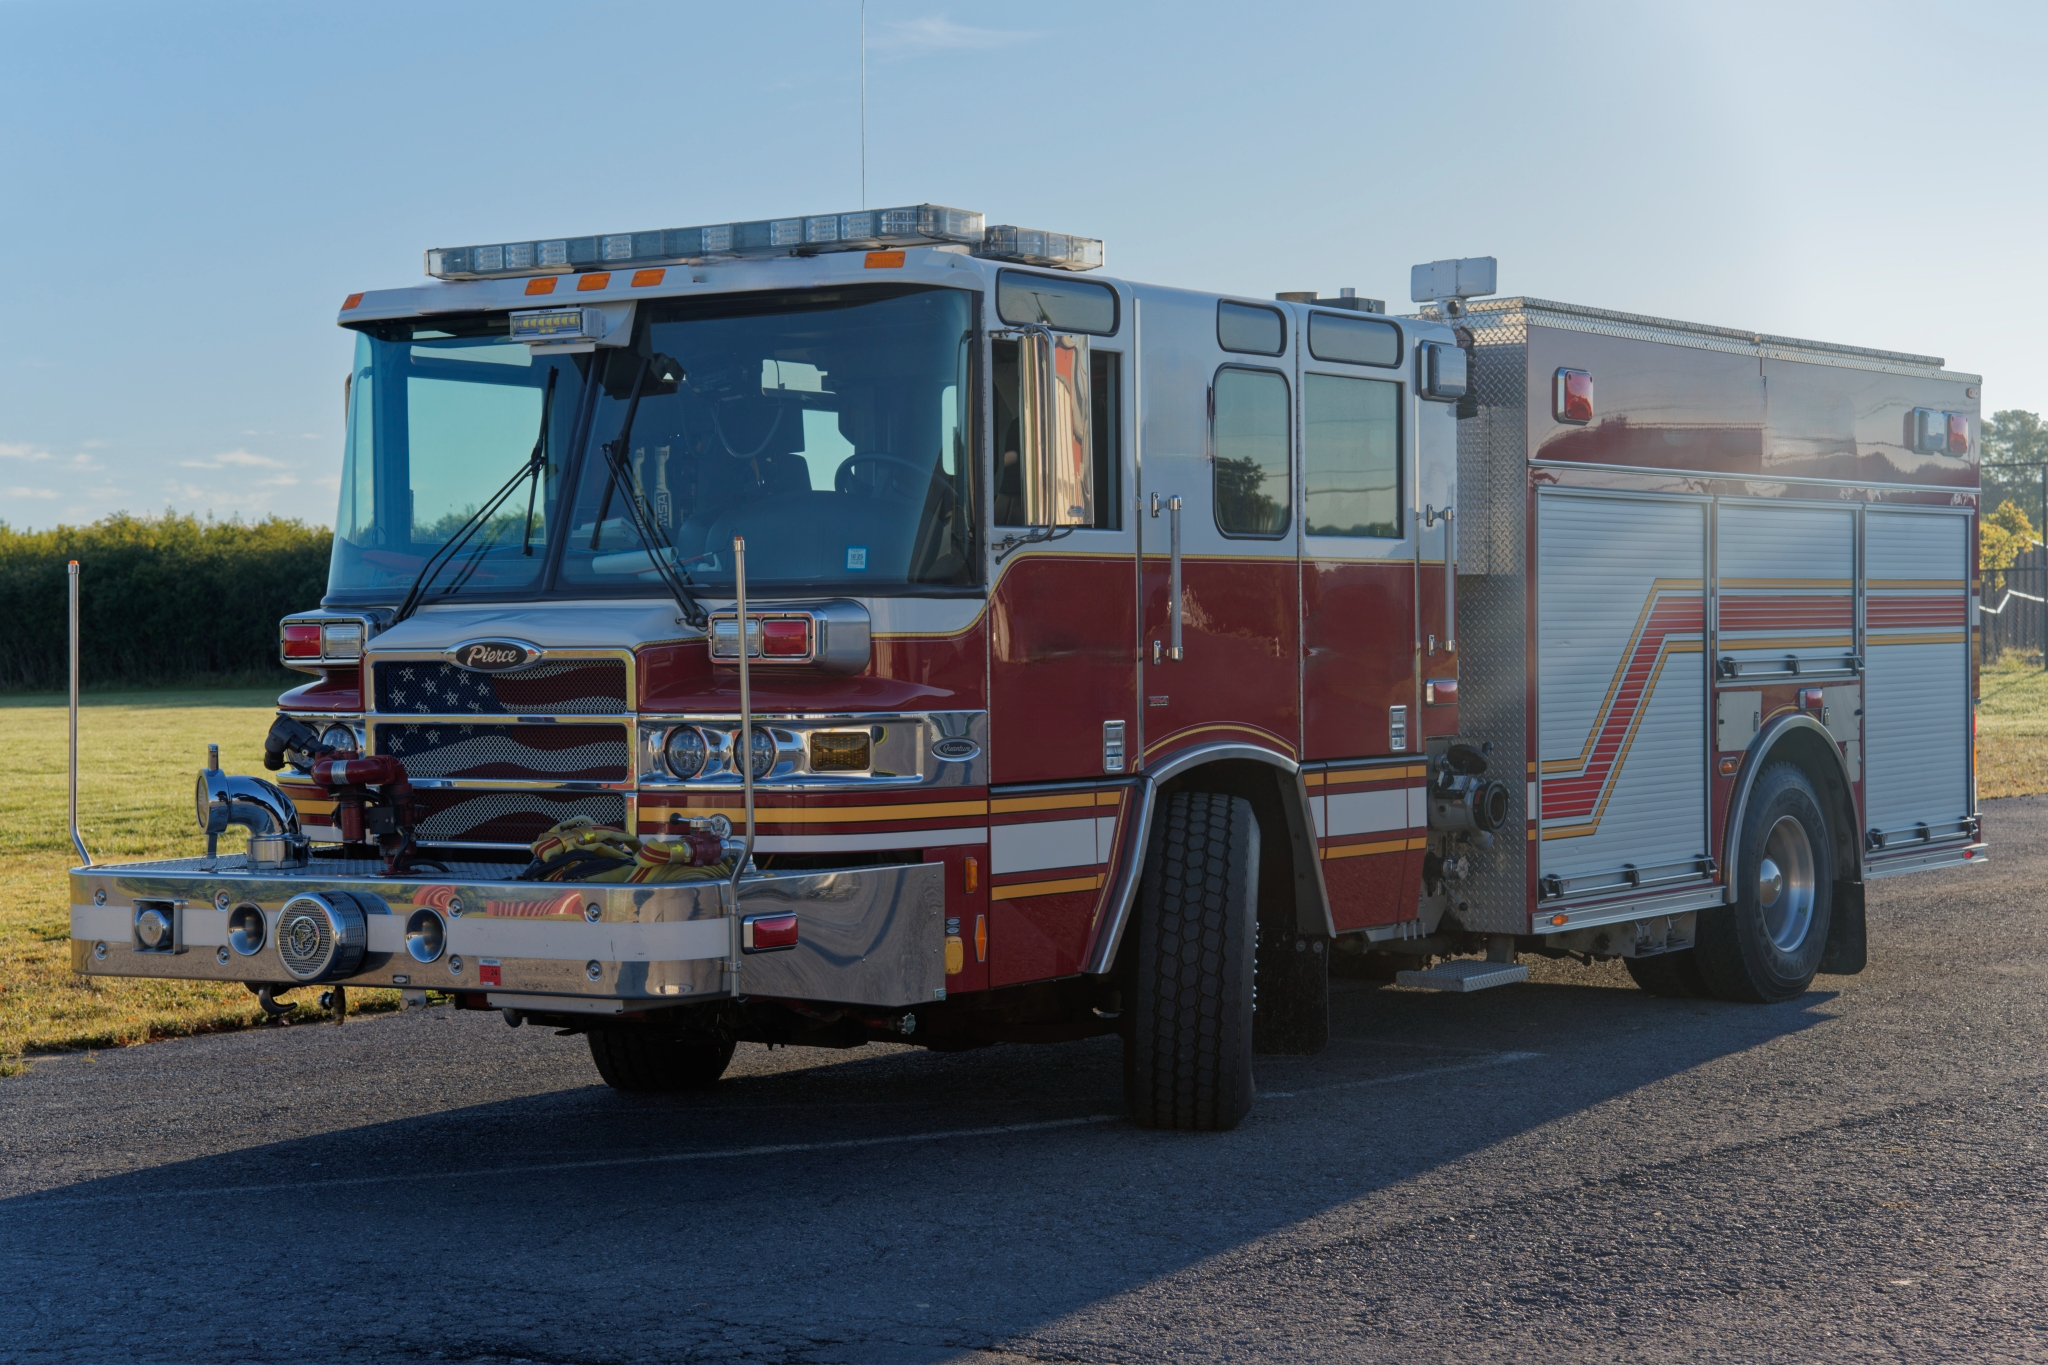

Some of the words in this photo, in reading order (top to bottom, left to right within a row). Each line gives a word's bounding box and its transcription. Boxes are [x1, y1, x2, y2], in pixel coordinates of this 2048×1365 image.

[657, 494, 668, 527] MSA
[467, 645, 517, 666] Pierce
[943, 744, 970, 753] Quantum
